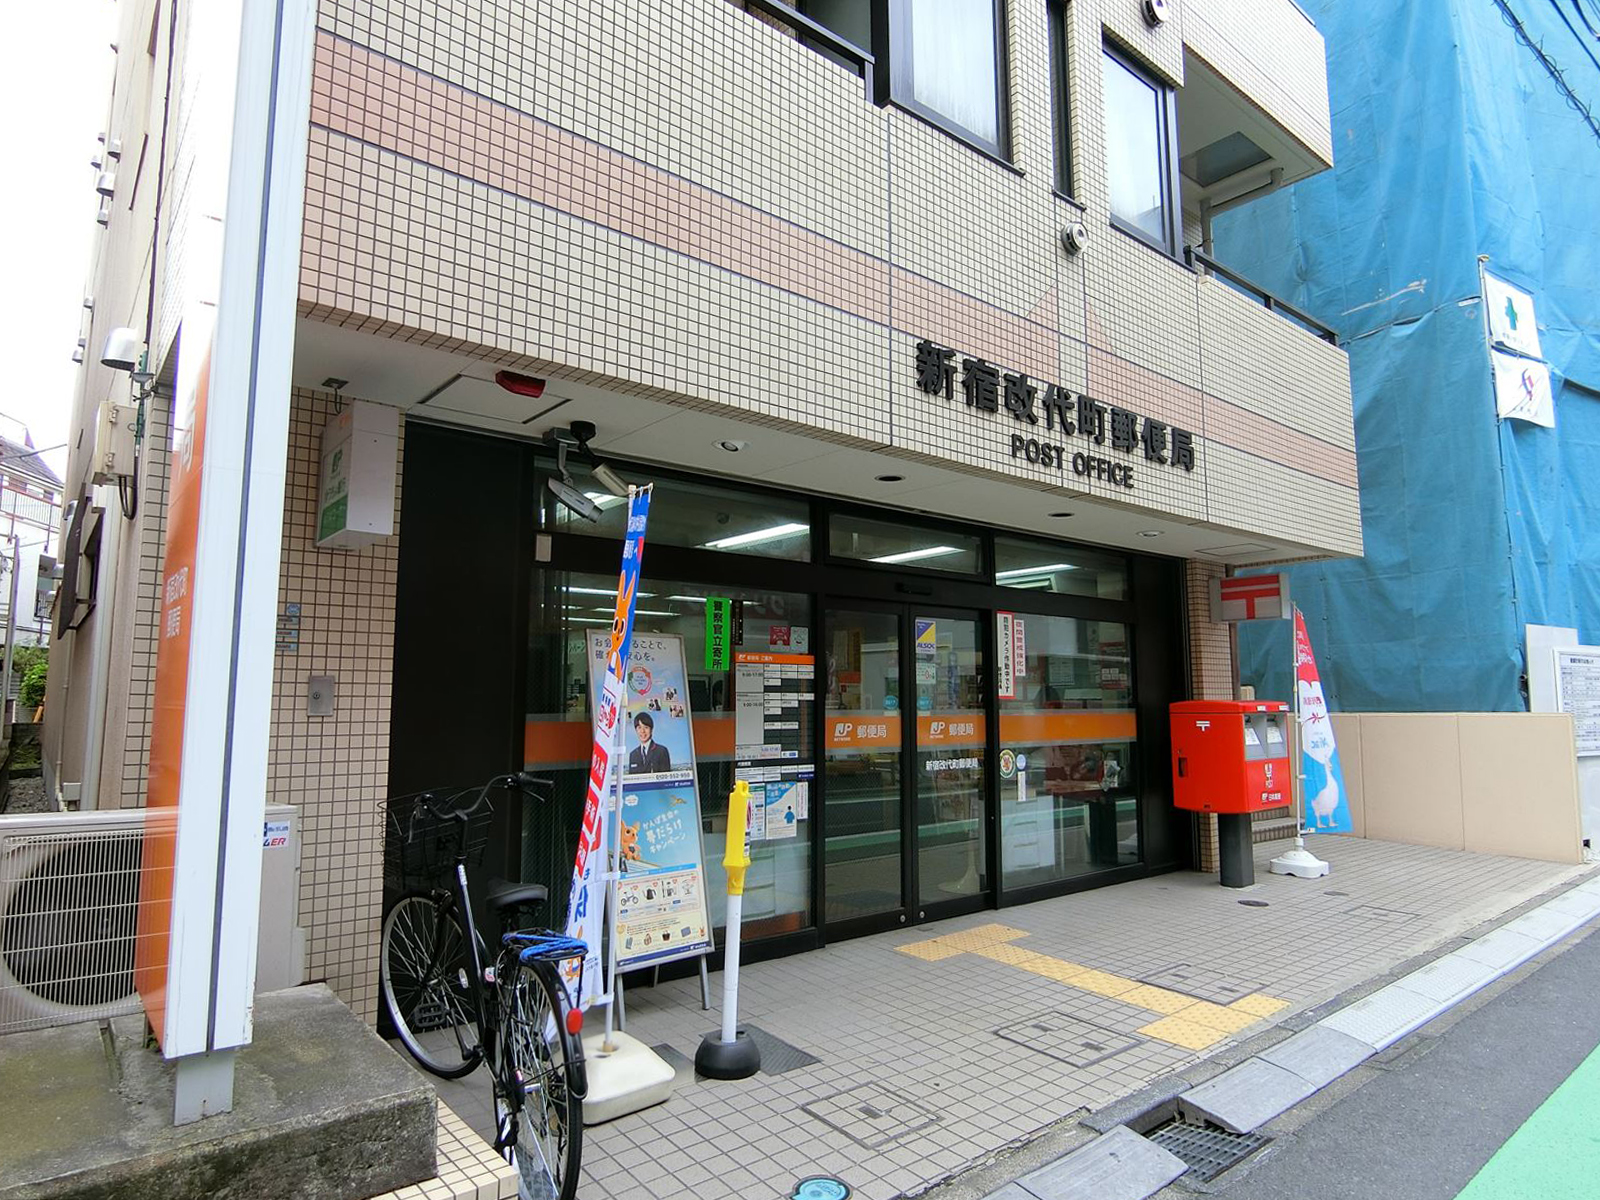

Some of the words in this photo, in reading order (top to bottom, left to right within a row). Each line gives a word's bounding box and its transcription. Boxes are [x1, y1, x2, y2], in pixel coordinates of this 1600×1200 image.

[916, 340, 1195, 471] 新宿改代町郵便局
[1011, 433, 1065, 470] POST
[1072, 452, 1134, 489] OFFICE
[713, 601, 723, 669] 警察官立寄所
[857, 724, 887, 738] 郵便局
[949, 723, 974, 736] 郵便局
[926, 758, 979, 771] 新宿改代町郵便局
